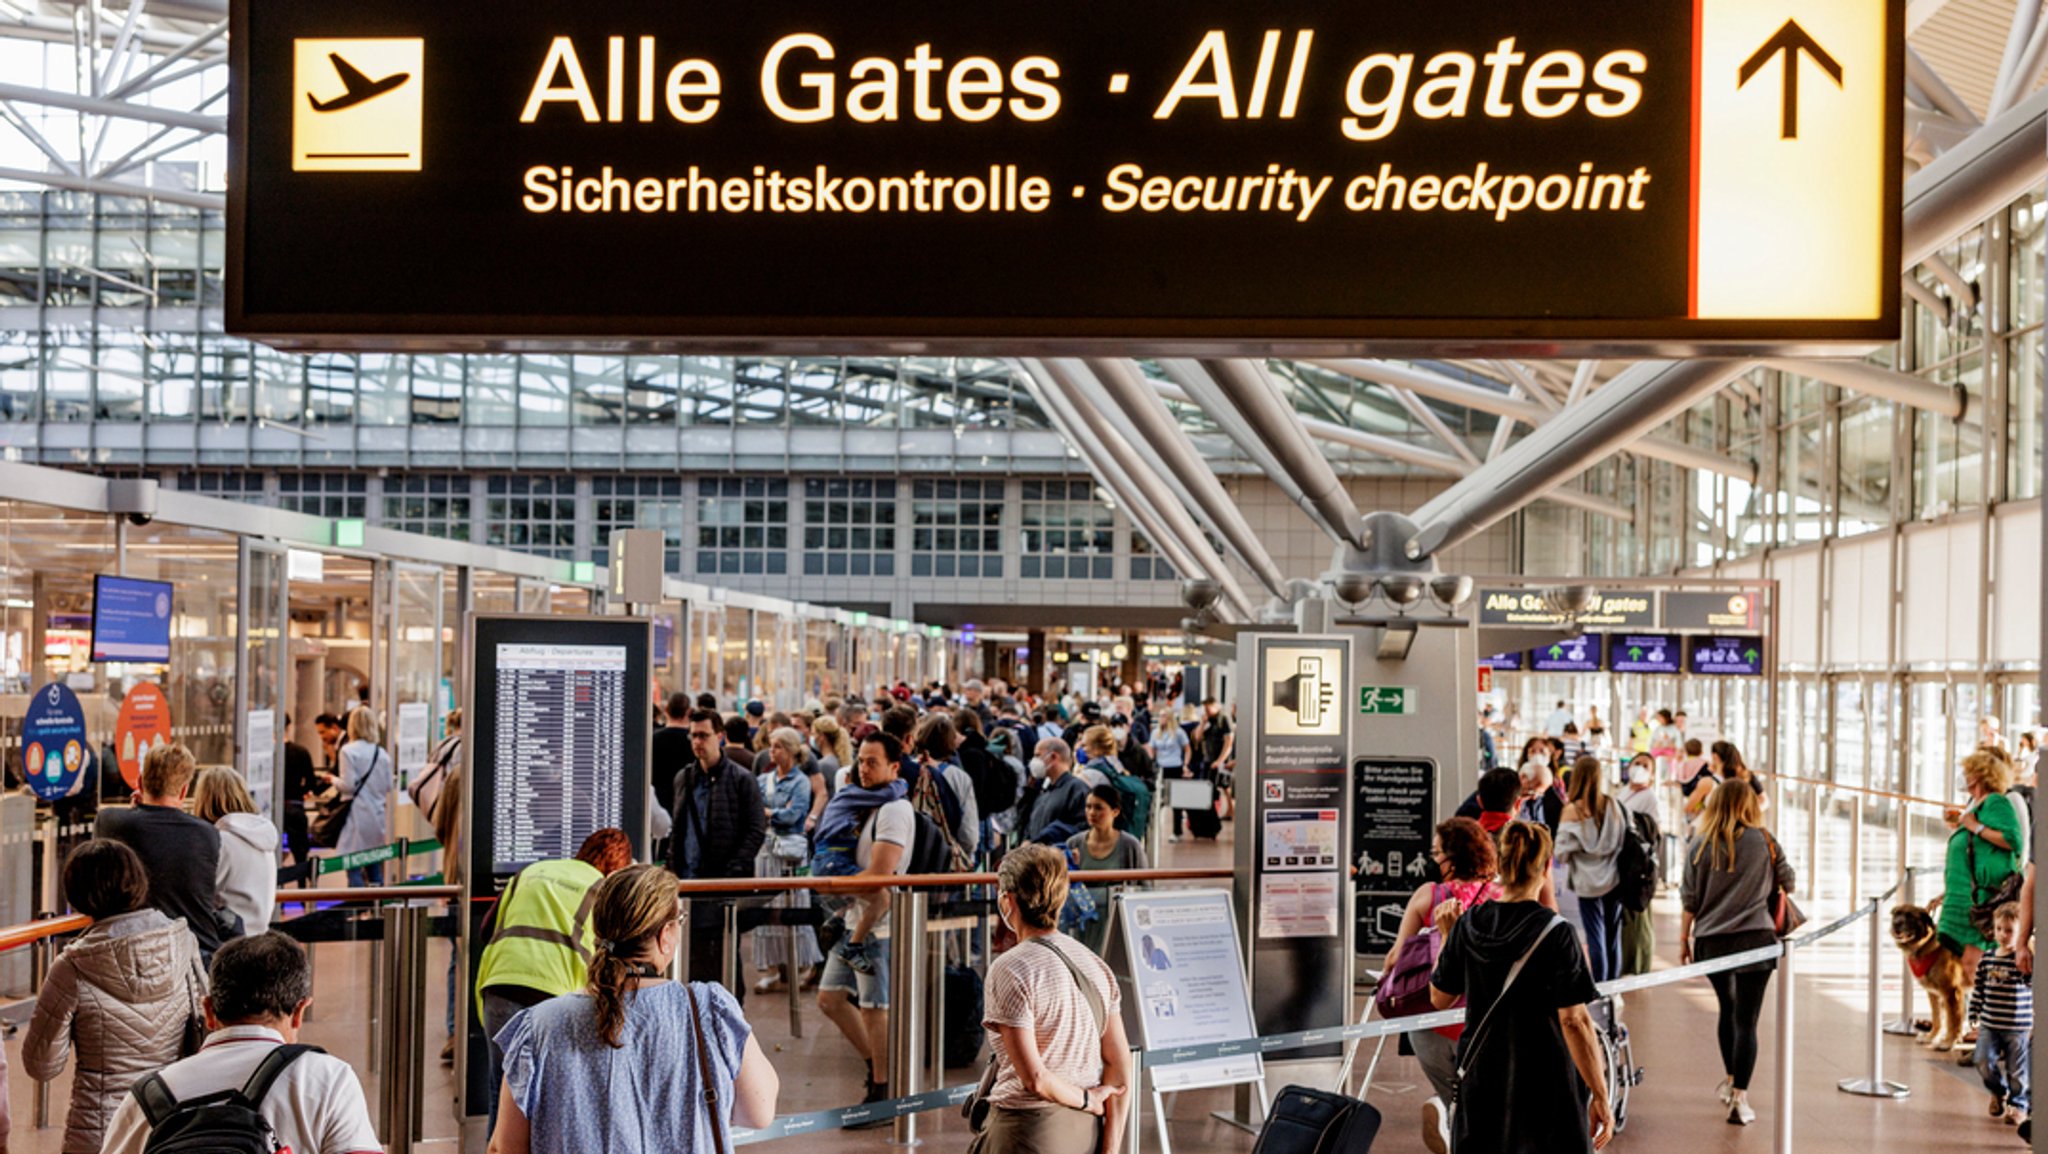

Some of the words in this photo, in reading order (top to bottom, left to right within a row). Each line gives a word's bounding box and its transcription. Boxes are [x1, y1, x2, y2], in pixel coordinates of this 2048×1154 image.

[519, 35, 721, 124] Alle
[760, 33, 1061, 123] Gates
[1153, 29, 1314, 119] All
[1340, 36, 1647, 141] gates
[523, 164, 1051, 213] Sicherheitskontrolle
[1102, 163, 1333, 222] Security
[1344, 162, 1651, 222] checkpoint
[1485, 593, 1519, 611] Alle
[1602, 596, 1649, 615] gates
[1265, 755, 1298, 765] Boarding
[1364, 765, 1382, 774] Bitte
[1410, 766, 1424, 775] Sie
